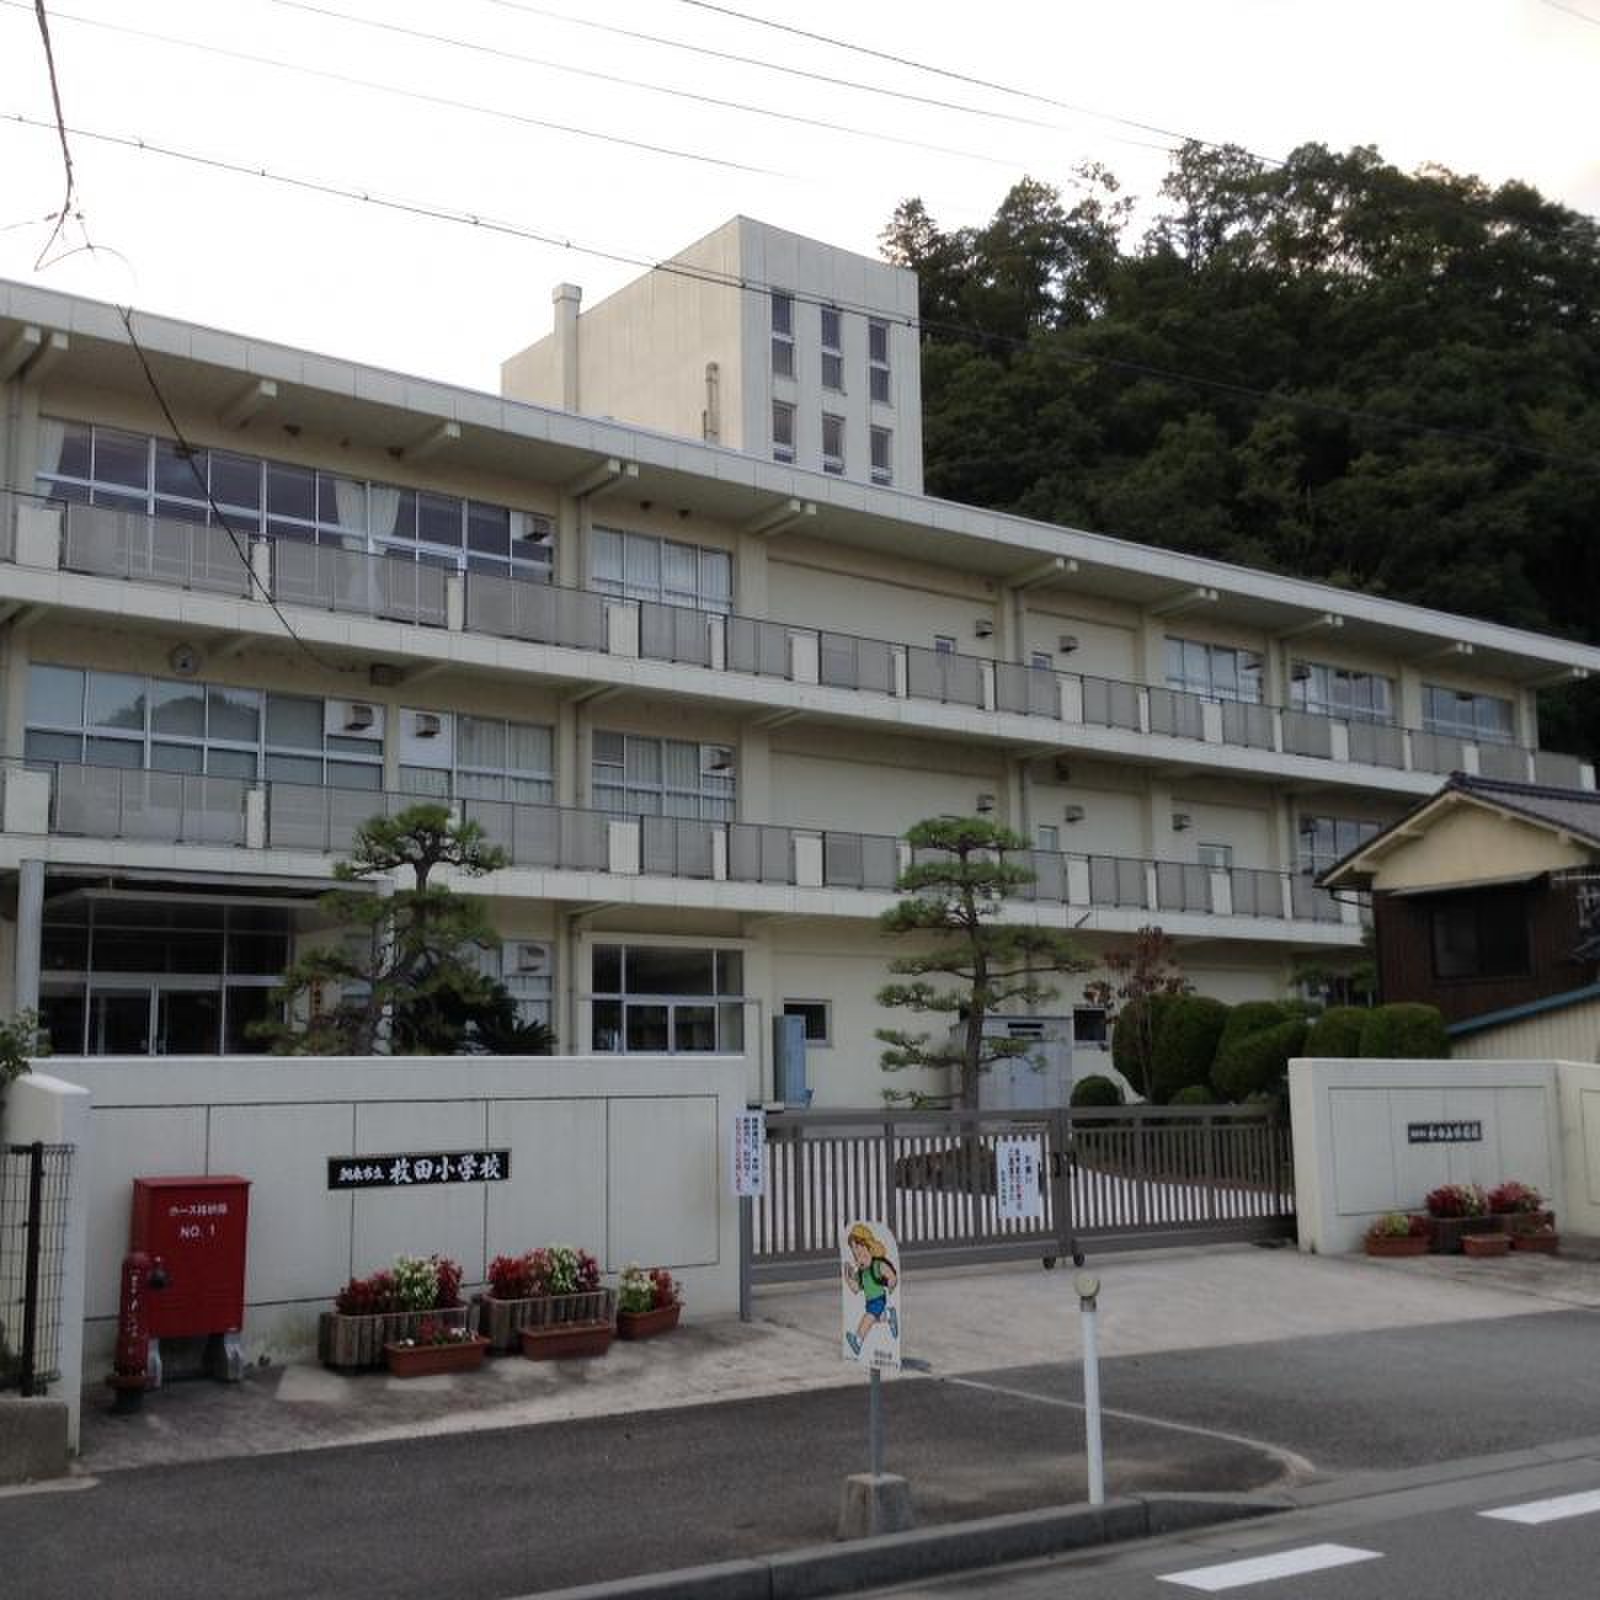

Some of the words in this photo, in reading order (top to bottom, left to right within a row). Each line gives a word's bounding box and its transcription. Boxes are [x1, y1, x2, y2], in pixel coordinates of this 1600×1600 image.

[389, 1153, 501, 1184] 枚田小学校
